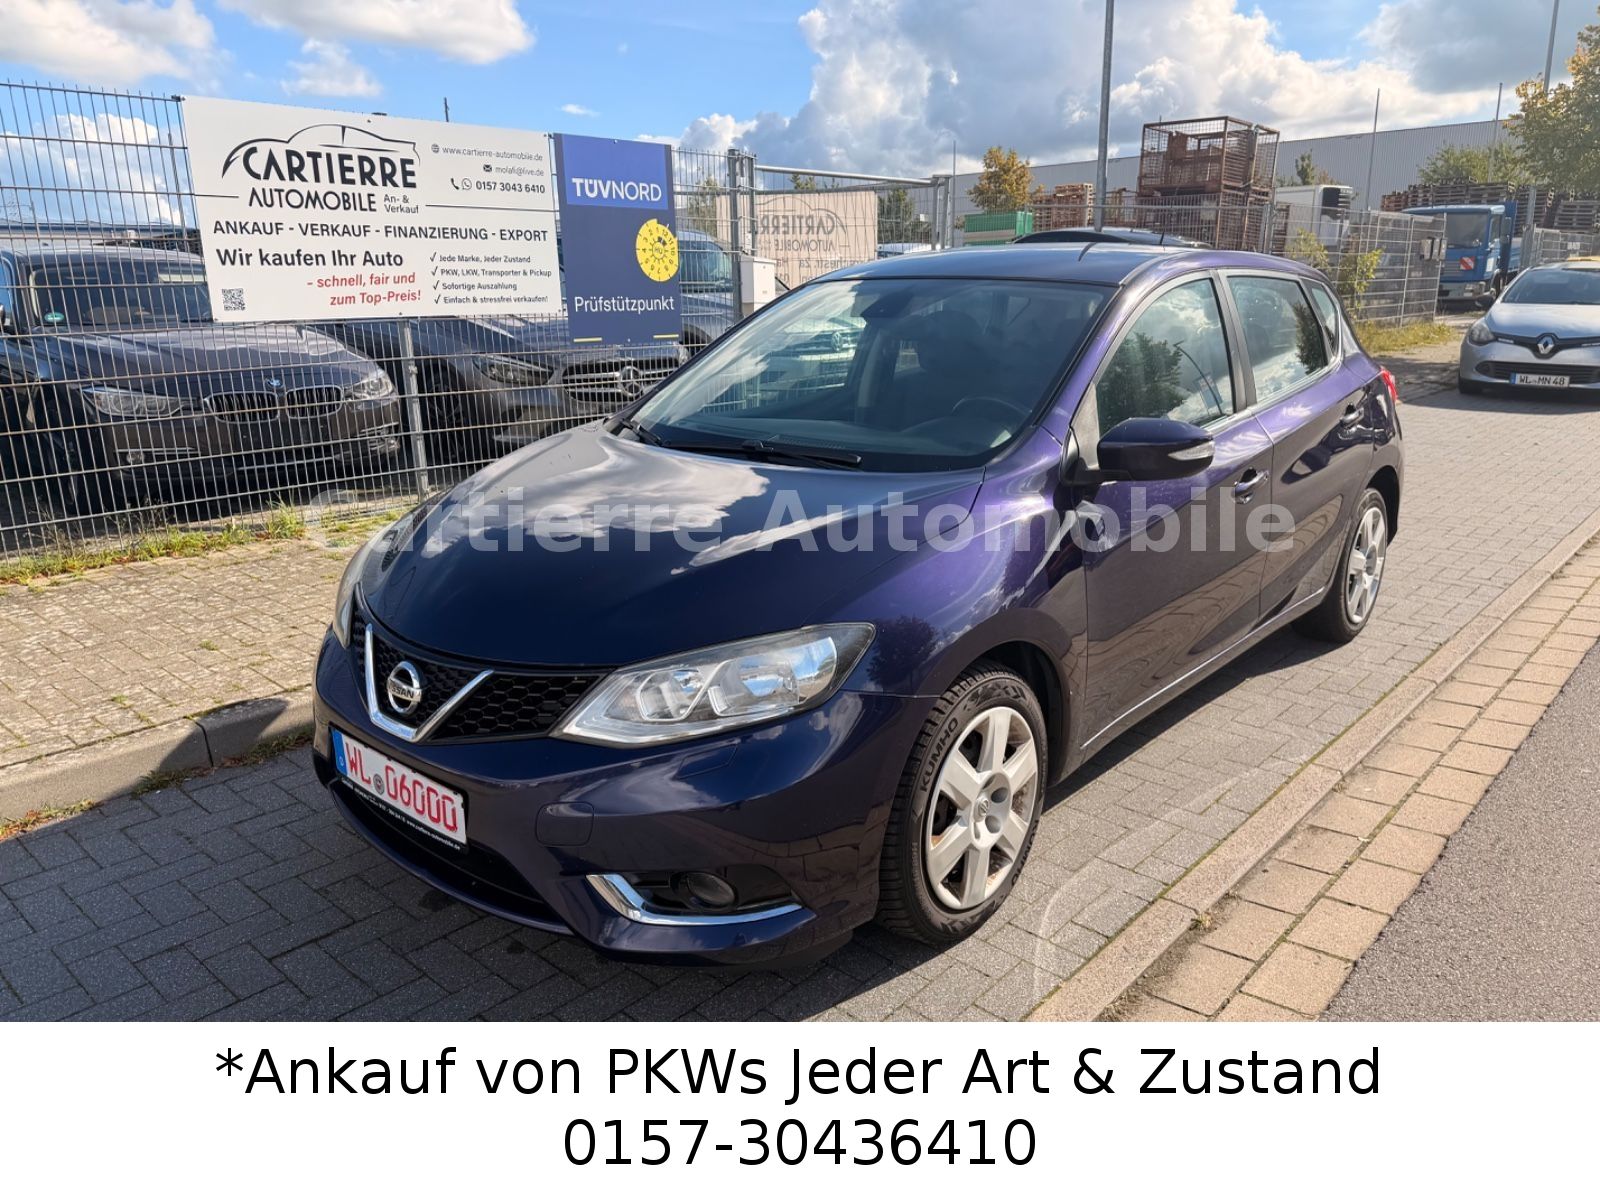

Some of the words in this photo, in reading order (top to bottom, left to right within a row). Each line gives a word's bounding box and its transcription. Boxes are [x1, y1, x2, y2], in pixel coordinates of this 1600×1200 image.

[442, 147, 543, 161] www.cartierre-automobile.de
[242, 146, 417, 188] CARTIERRE
[475, 181, 497, 191] 0157
[500, 182, 523, 192] 3043
[524, 184, 545, 194] 6410
[248, 187, 377, 212] AUTOMOBILE
[383, 193, 400, 204] An-
[402, 194, 410, 204] &
[384, 204, 419, 214] Verkauf
[213, 220, 284, 235] ANKAUF
[298, 222, 371, 238] VERKAUF
[384, 225, 488, 240] FINANZIERUNG
[500, 229, 548, 242] EXPORT
[216, 248, 252, 266] Wir
[259, 248, 326, 267] kaufen
[332, 250, 356, 267] Ihr
[362, 250, 404, 267] Auto
[439, 255, 456, 263] Jede
[484, 255, 502, 263] Jeder
[503, 255, 531, 263] Zustand
[317, 274, 366, 288] schnell,
[369, 273, 389, 286] fair
[393, 272, 415, 285] und
[440, 268, 460, 277] PKW,
[461, 268, 480, 277] LKW,
[481, 269, 521, 278] Transporter
[523, 269, 528, 277] &
[529, 269, 552, 278] Pickup
[442, 282, 476, 291] Sofortige
[477, 282, 517, 291] Auszahlung
[330, 294, 356, 306] zum
[360, 290, 421, 306] Top-Preis!
[443, 296, 471, 304] Einfach
[480, 295, 512, 303] stressfrei
[514, 295, 548, 303] verkaufen!
[574, 295, 675, 315] Prüfstützpunkt
[920, 717, 958, 792] KUMHO
[345, 742, 371, 786] WL
[385, 765, 458, 832] 06000
